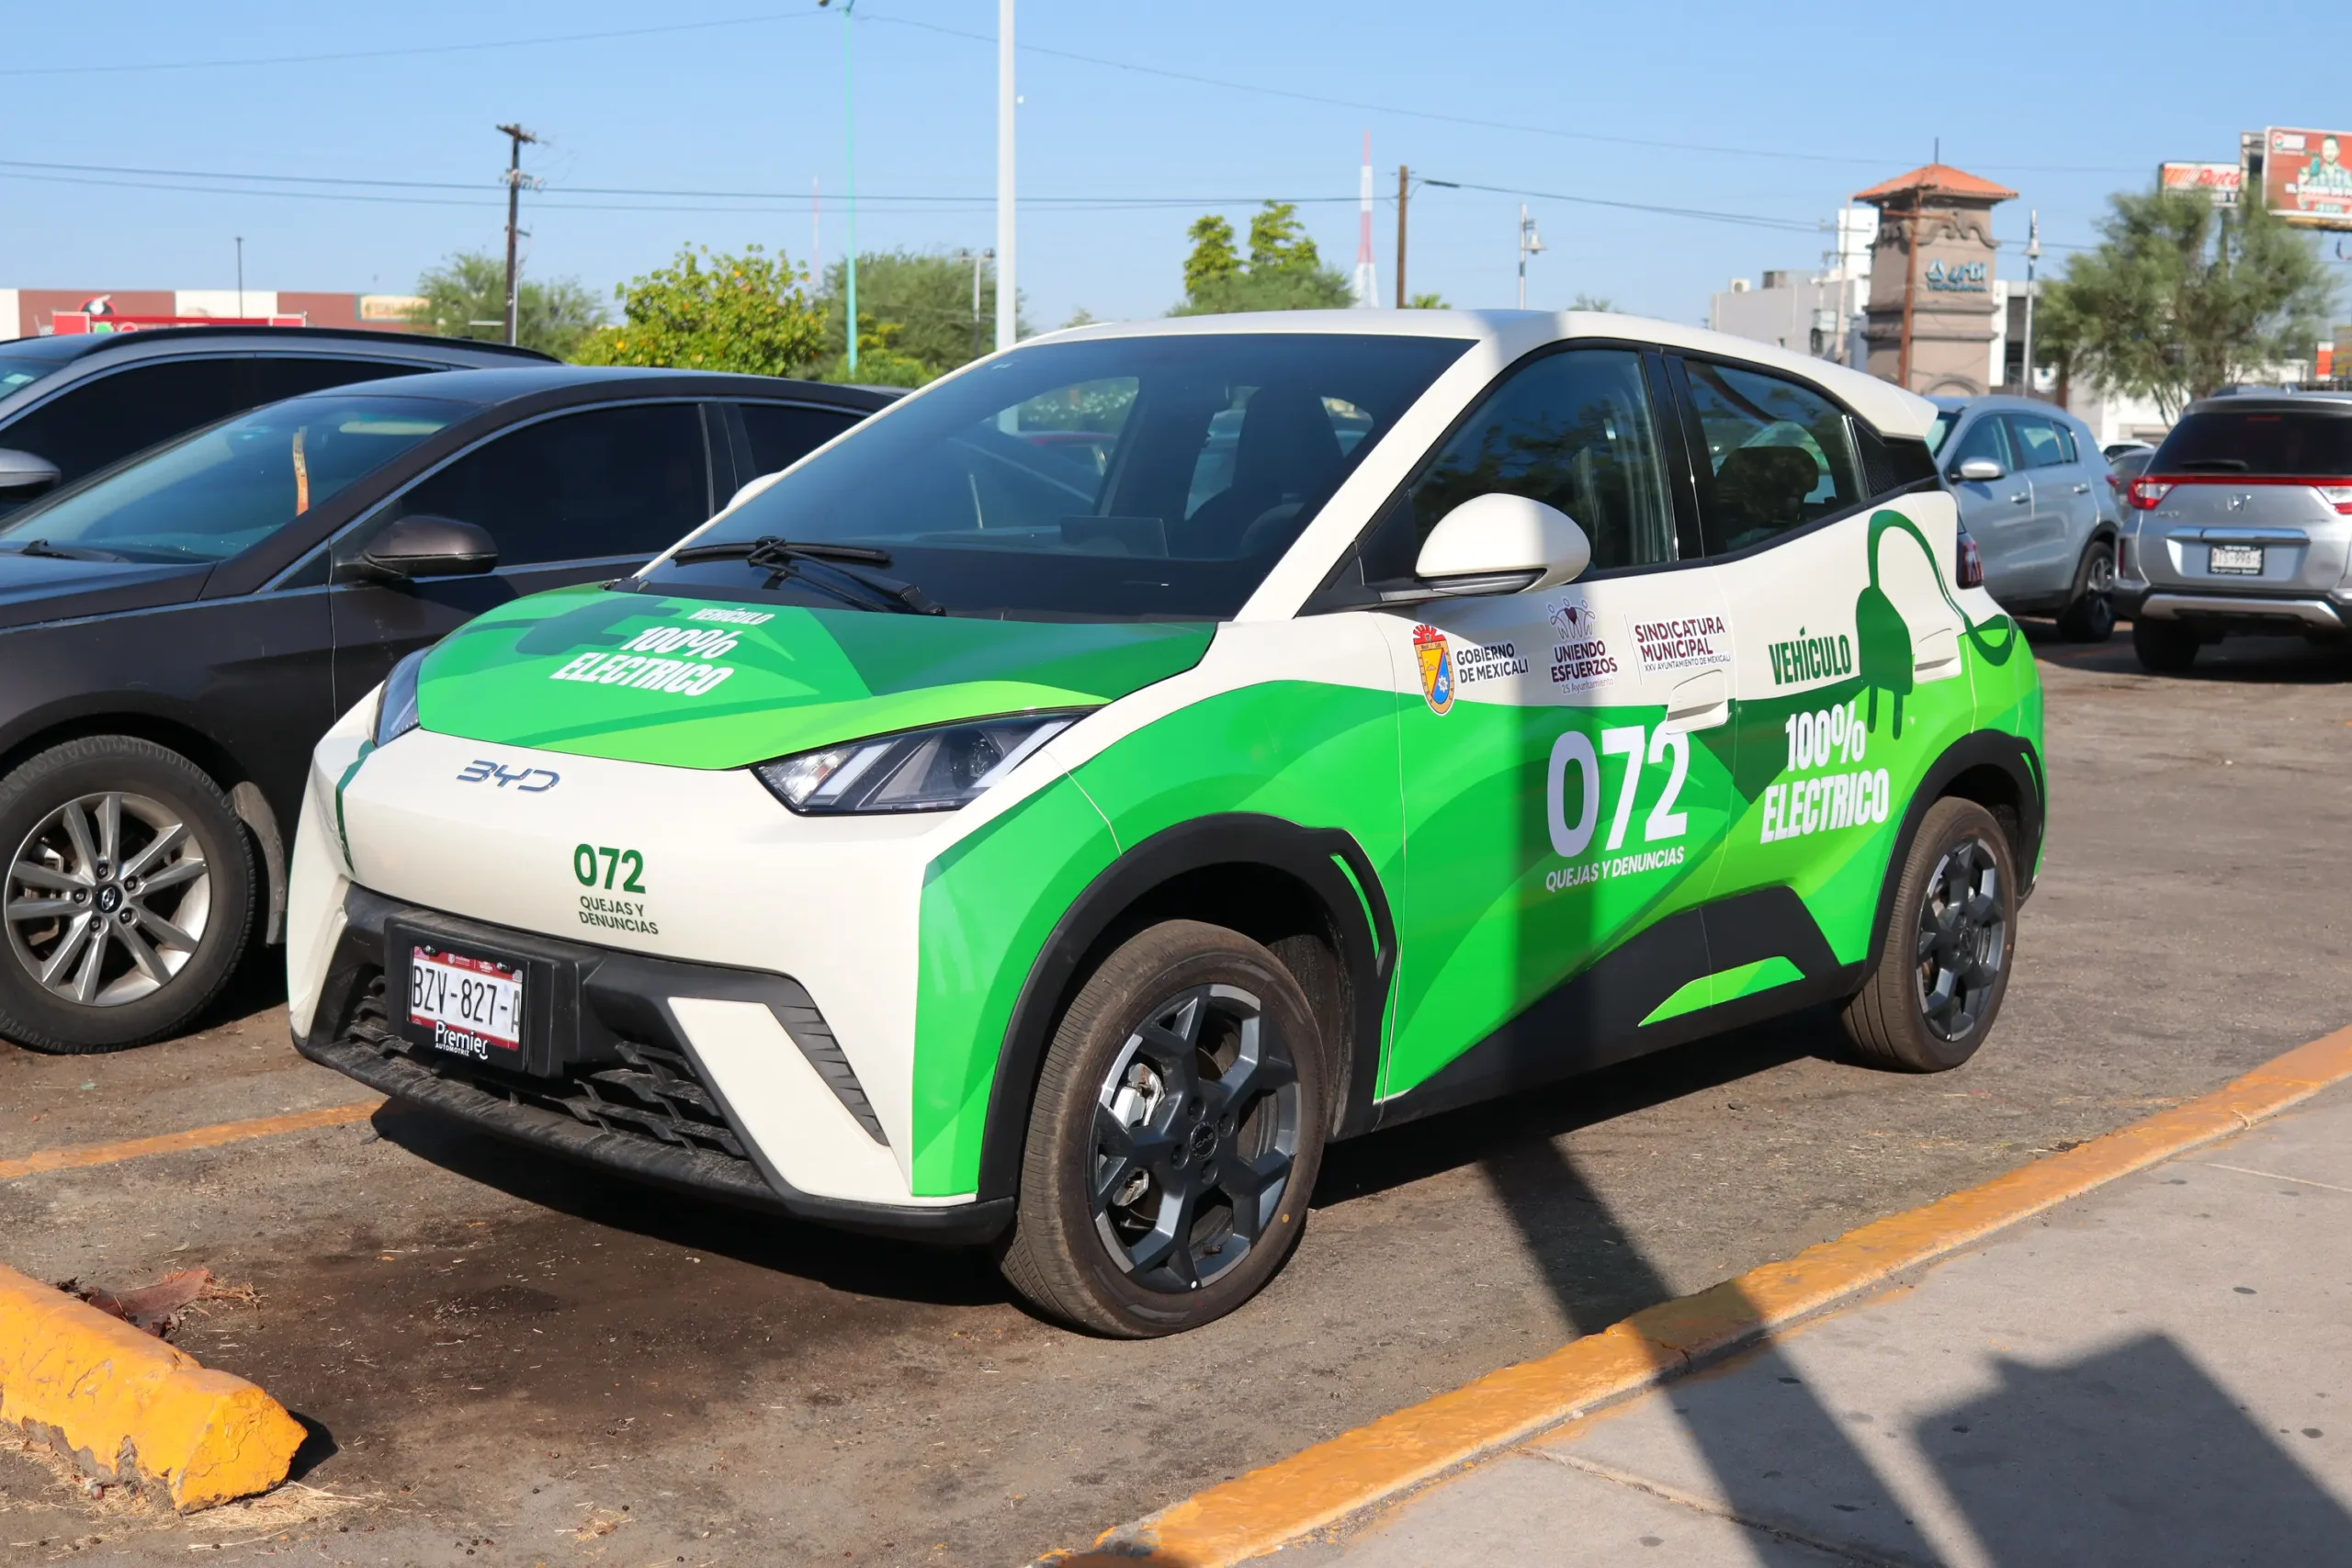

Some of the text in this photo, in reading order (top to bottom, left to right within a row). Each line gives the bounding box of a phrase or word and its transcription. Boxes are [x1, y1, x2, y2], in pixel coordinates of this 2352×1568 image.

[687, 607, 775, 626] VEHÍCULO
[1634, 616, 1725, 643] SINDICATURA
[619, 626, 744, 659] 100%
[1456, 643, 1515, 666] GOBIERNO
[1554, 640, 1606, 663] UNIENDO
[1639, 637, 1713, 662] MUNICIPAL
[1768, 626, 1852, 685] VEHÍCULO
[548, 652, 735, 696] ELECTRICO
[1459, 659, 1529, 683] DE MEXICALI
[1551, 657, 1618, 682] ESFUERZOS
[1657, 659, 1699, 671] AYUNTAMIENTO
[1700, 657, 1707, 666] DE
[1707, 654, 1731, 665] MEXICALI
[1562, 677, 1614, 694] 25 Ayuntamiento
[1785, 701, 1866, 772] 100%
[456, 760, 560, 793] BYD
[1547, 720, 1690, 858] 072
[1759, 768, 1890, 844] ELECTRICO
[573, 843, 646, 894] 072
[1545, 846, 1685, 892] QUEJAS Y DENUNCIAS
[580, 896, 644, 917] QUEJAS Y
[579, 911, 659, 935] DENUNCIAS
[413, 964, 521, 1033] BZV-827-A
[435, 1021, 489, 1060] Premier
[435, 1043, 469, 1056] AUTOMOTRIZ
